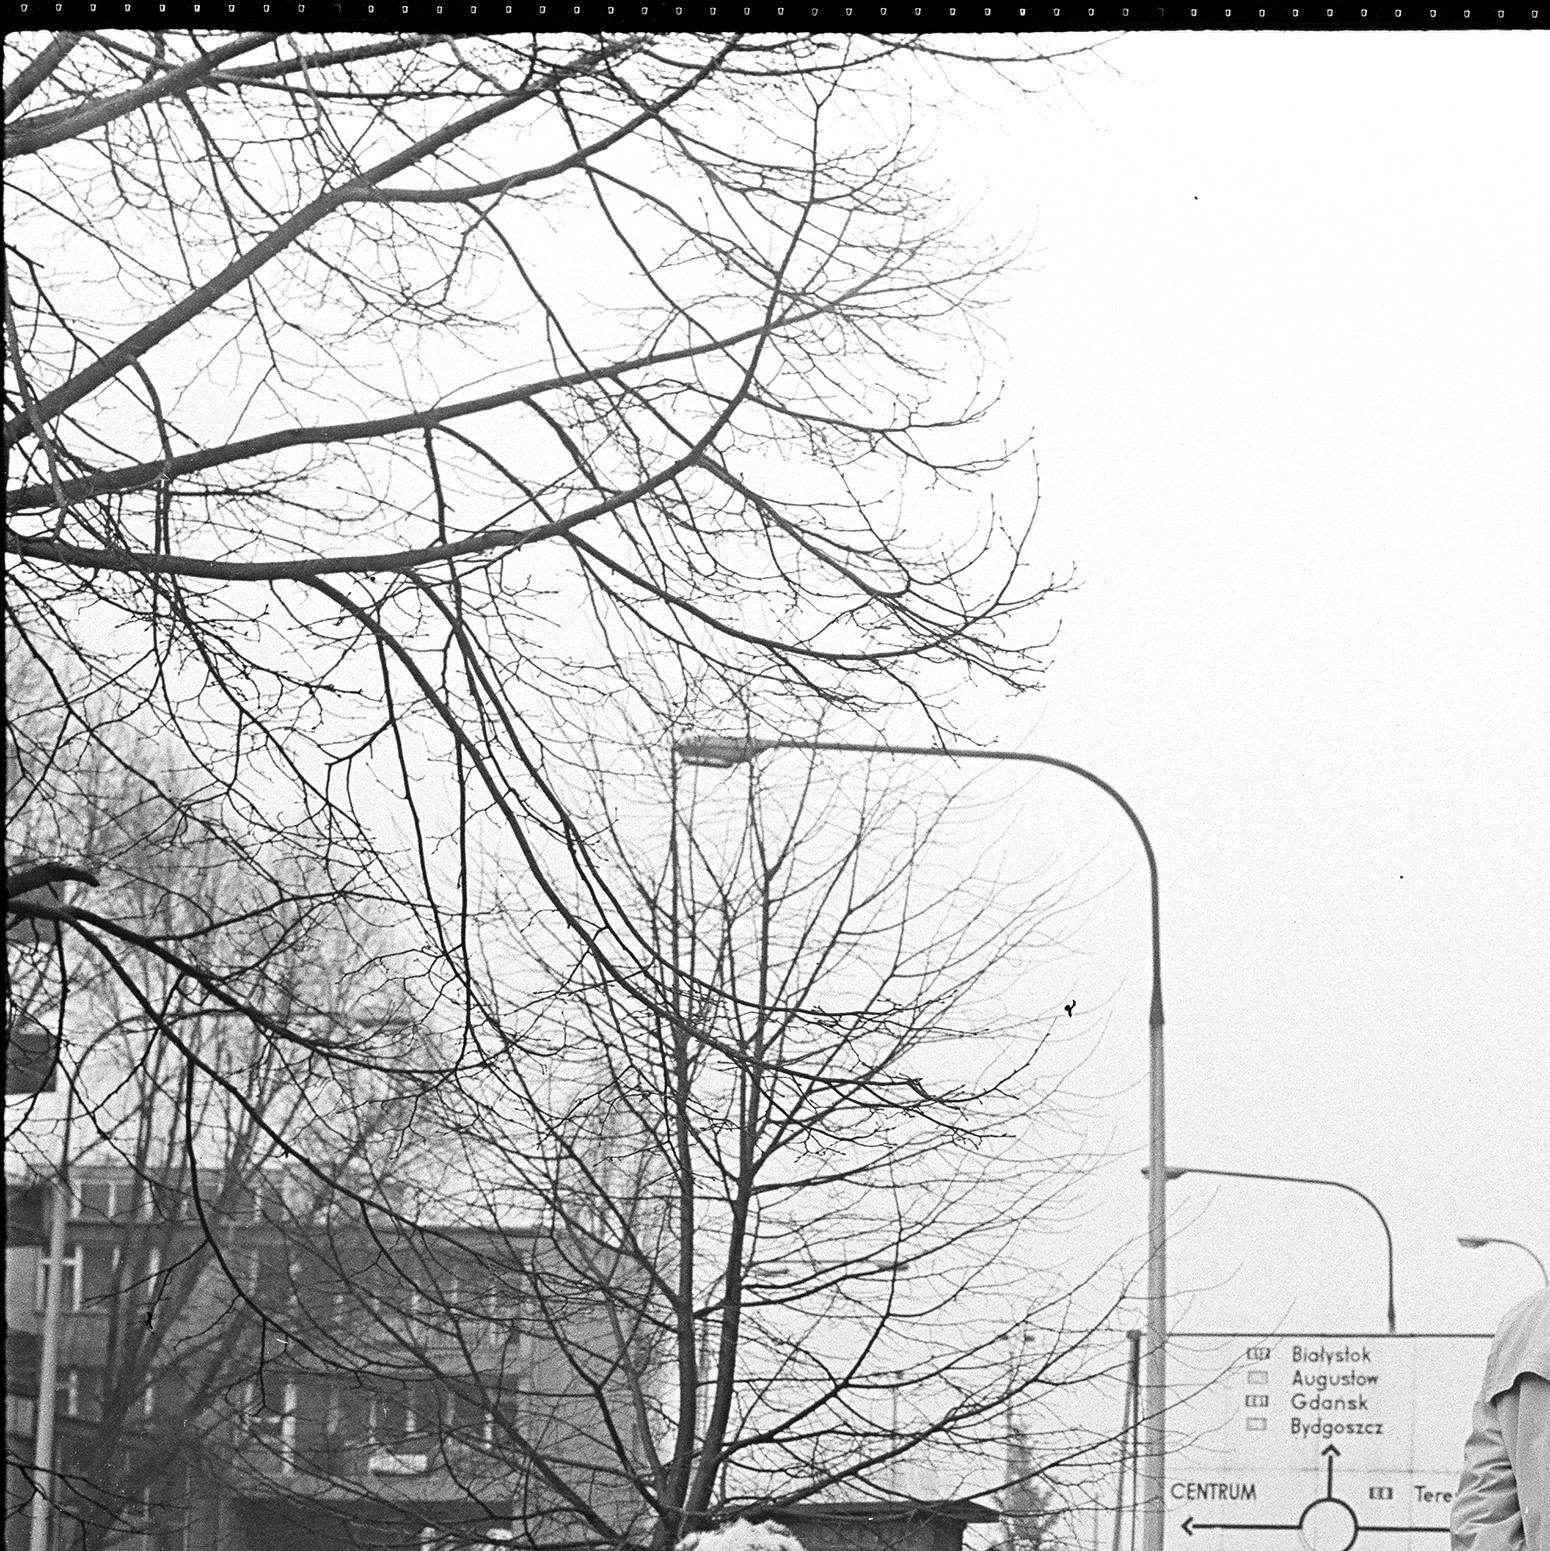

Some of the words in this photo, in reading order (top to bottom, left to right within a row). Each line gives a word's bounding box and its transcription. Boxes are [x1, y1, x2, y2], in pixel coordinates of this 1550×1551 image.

[1292, 1346, 1371, 1366] Białystok
[1291, 1417, 1384, 1439] Bydgoszcz
[1170, 1482, 1257, 1501] CENTRUM
[1414, 1485, 1453, 1503] Tere
